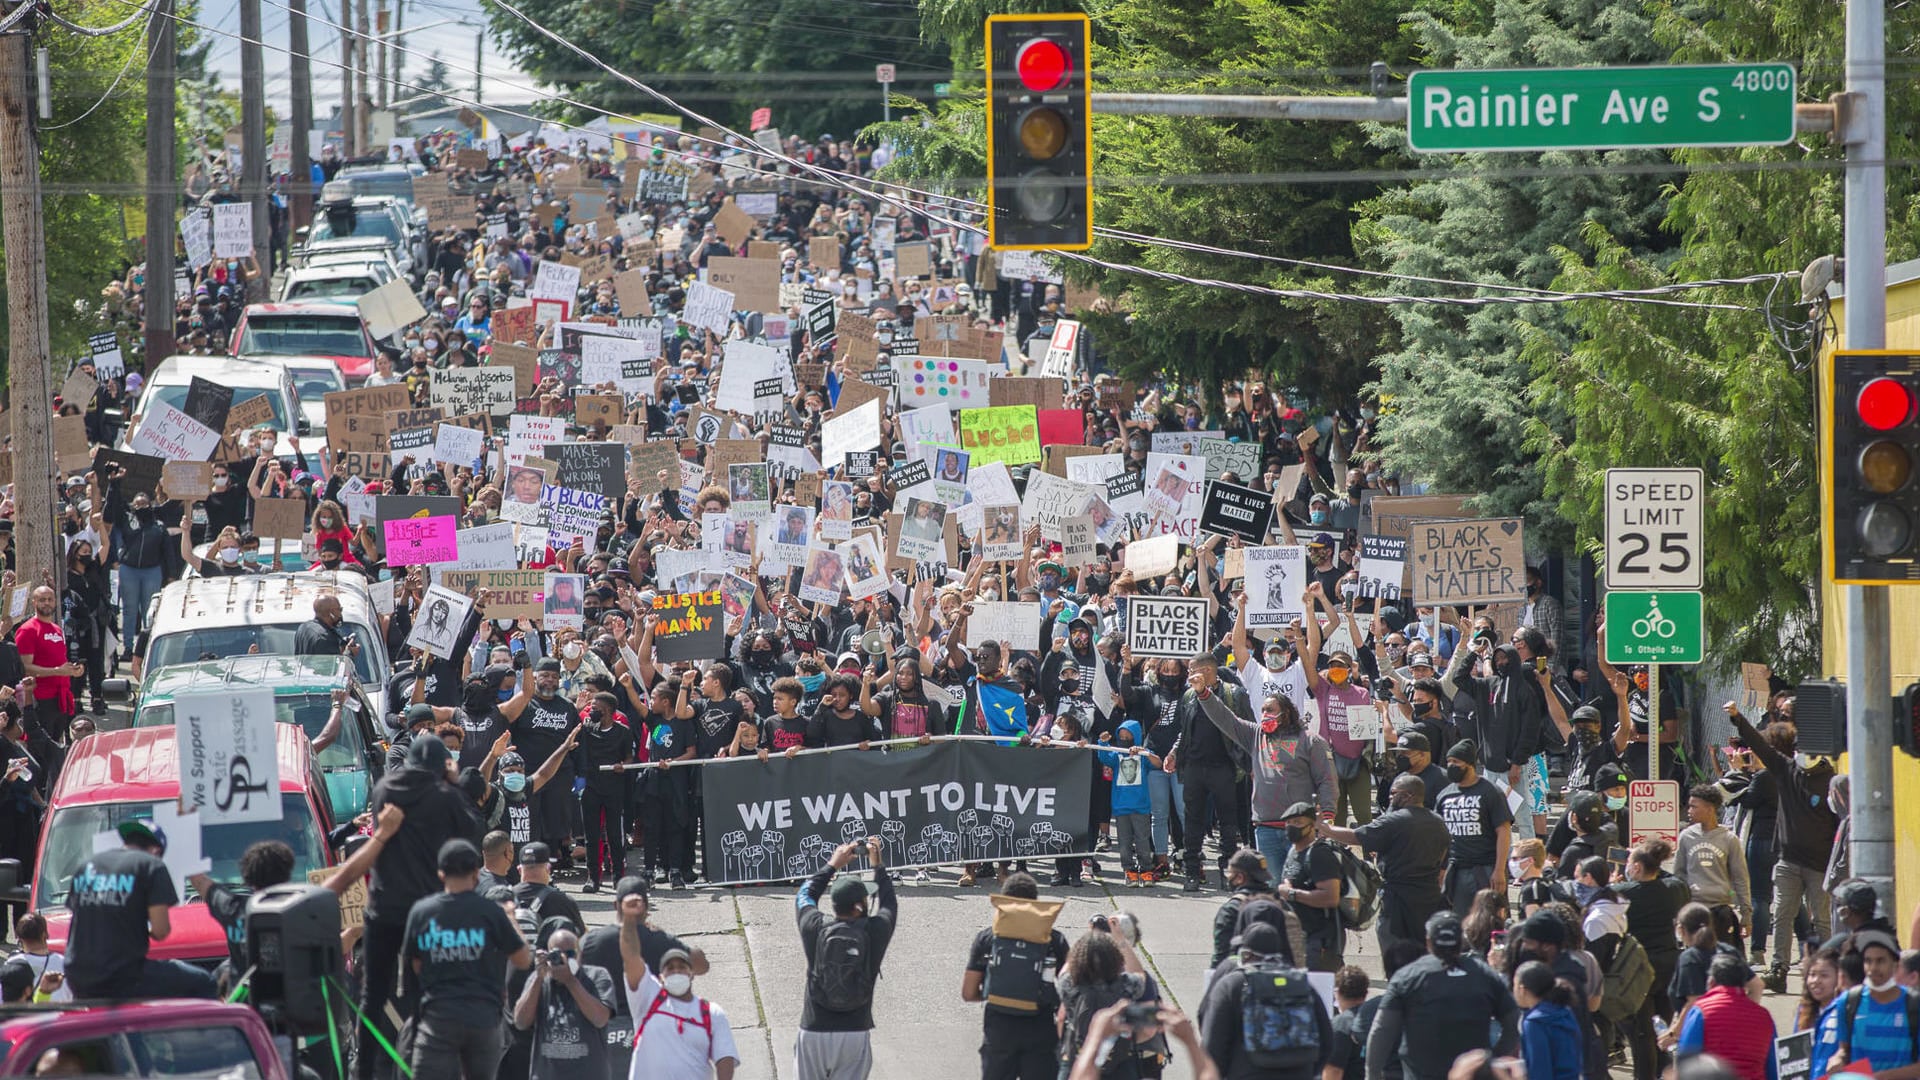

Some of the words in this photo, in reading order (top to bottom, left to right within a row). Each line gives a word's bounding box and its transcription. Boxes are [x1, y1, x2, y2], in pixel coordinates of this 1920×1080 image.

[1732, 70, 1789, 92] 4800
[1424, 86, 1578, 128] Rainier
[1601, 89, 1669, 124] Ave
[1697, 87, 1721, 122] S
[102, 336, 116, 347] WANT
[633, 361, 652, 369] WANT
[635, 368, 650, 376] LIVE
[434, 372, 468, 384] Melanin
[764, 378, 782, 388] WANT
[766, 387, 780, 395] LIVE
[330, 392, 404, 414] DEFUND
[454, 406, 468, 416] WE
[166, 409, 208, 438] RACISM
[772, 426, 782, 434] WE
[784, 427, 806, 437] WANT
[158, 420, 167, 434] IS
[177, 433, 186, 445] A
[390, 434, 401, 442] WE
[516, 433, 556, 441] KILLING
[773, 434, 784, 442] TO
[784, 436, 802, 444] LIVE
[143, 428, 193, 461] PANDEMIC
[393, 440, 402, 448] TO
[404, 438, 420, 447] LIVE
[562, 446, 600, 458] MAKE
[1202, 442, 1261, 463] ABOLISH
[557, 458, 610, 471] RACISM
[890, 471, 904, 482] WE
[904, 462, 928, 476] WANT
[1206, 456, 1252, 477] SPD
[564, 472, 601, 482] WRONG
[896, 478, 908, 488] TO
[908, 472, 928, 485] LIVE
[1106, 479, 1116, 489] WE
[1117, 472, 1138, 486] WANT
[1044, 488, 1074, 504] SAY
[1110, 488, 1120, 496] TO
[1122, 482, 1138, 494] LIVE
[1616, 484, 1694, 502] SPEED
[560, 487, 604, 510] BLACK
[1216, 489, 1240, 504] BLACK
[1244, 496, 1266, 510] LIVES
[557, 505, 601, 521] ECONOMIC
[1222, 506, 1254, 521] MATTER
[1624, 508, 1685, 526] LIMIT
[388, 522, 449, 542] JUSTICE
[1427, 526, 1490, 550] BLACK
[1364, 538, 1377, 546] WE
[1379, 539, 1406, 549] WANT
[1366, 548, 1378, 556] TO
[1380, 549, 1401, 558] LIVE
[1434, 548, 1502, 572] LIVES
[1617, 532, 1691, 574] 25
[448, 572, 481, 587] KNOW
[488, 572, 544, 588] JUSTICE
[1425, 567, 1514, 600] MATTER
[490, 590, 529, 605] PEACE
[652, 590, 722, 610] #JUSTICE
[686, 606, 698, 618] 4
[1136, 604, 1201, 620] BLACK
[654, 616, 712, 636] MANNY
[1136, 619, 1200, 636] LIVES
[1135, 635, 1198, 652] MATTER
[1624, 645, 1633, 654] To
[1638, 645, 1666, 654] Othello
[1670, 645, 1685, 654] Sta
[534, 708, 568, 722] Blessed
[190, 716, 206, 778] Support
[1634, 784, 1653, 796] NO
[737, 798, 793, 832] WE
[802, 788, 912, 824] WANT
[920, 782, 965, 814] TO
[974, 782, 1056, 817] LIVE
[1443, 795, 1482, 809] BLACK
[1635, 801, 1674, 813] STOPS
[1444, 808, 1480, 822] LIVES
[1445, 822, 1482, 836] MATTER
[71, 863, 135, 894] URBAN
[80, 890, 130, 906] FAMILY
[418, 920, 486, 952] URBAN
[430, 947, 484, 963] FAMILY
[1780, 1058, 1810, 1077] JUSTICE
